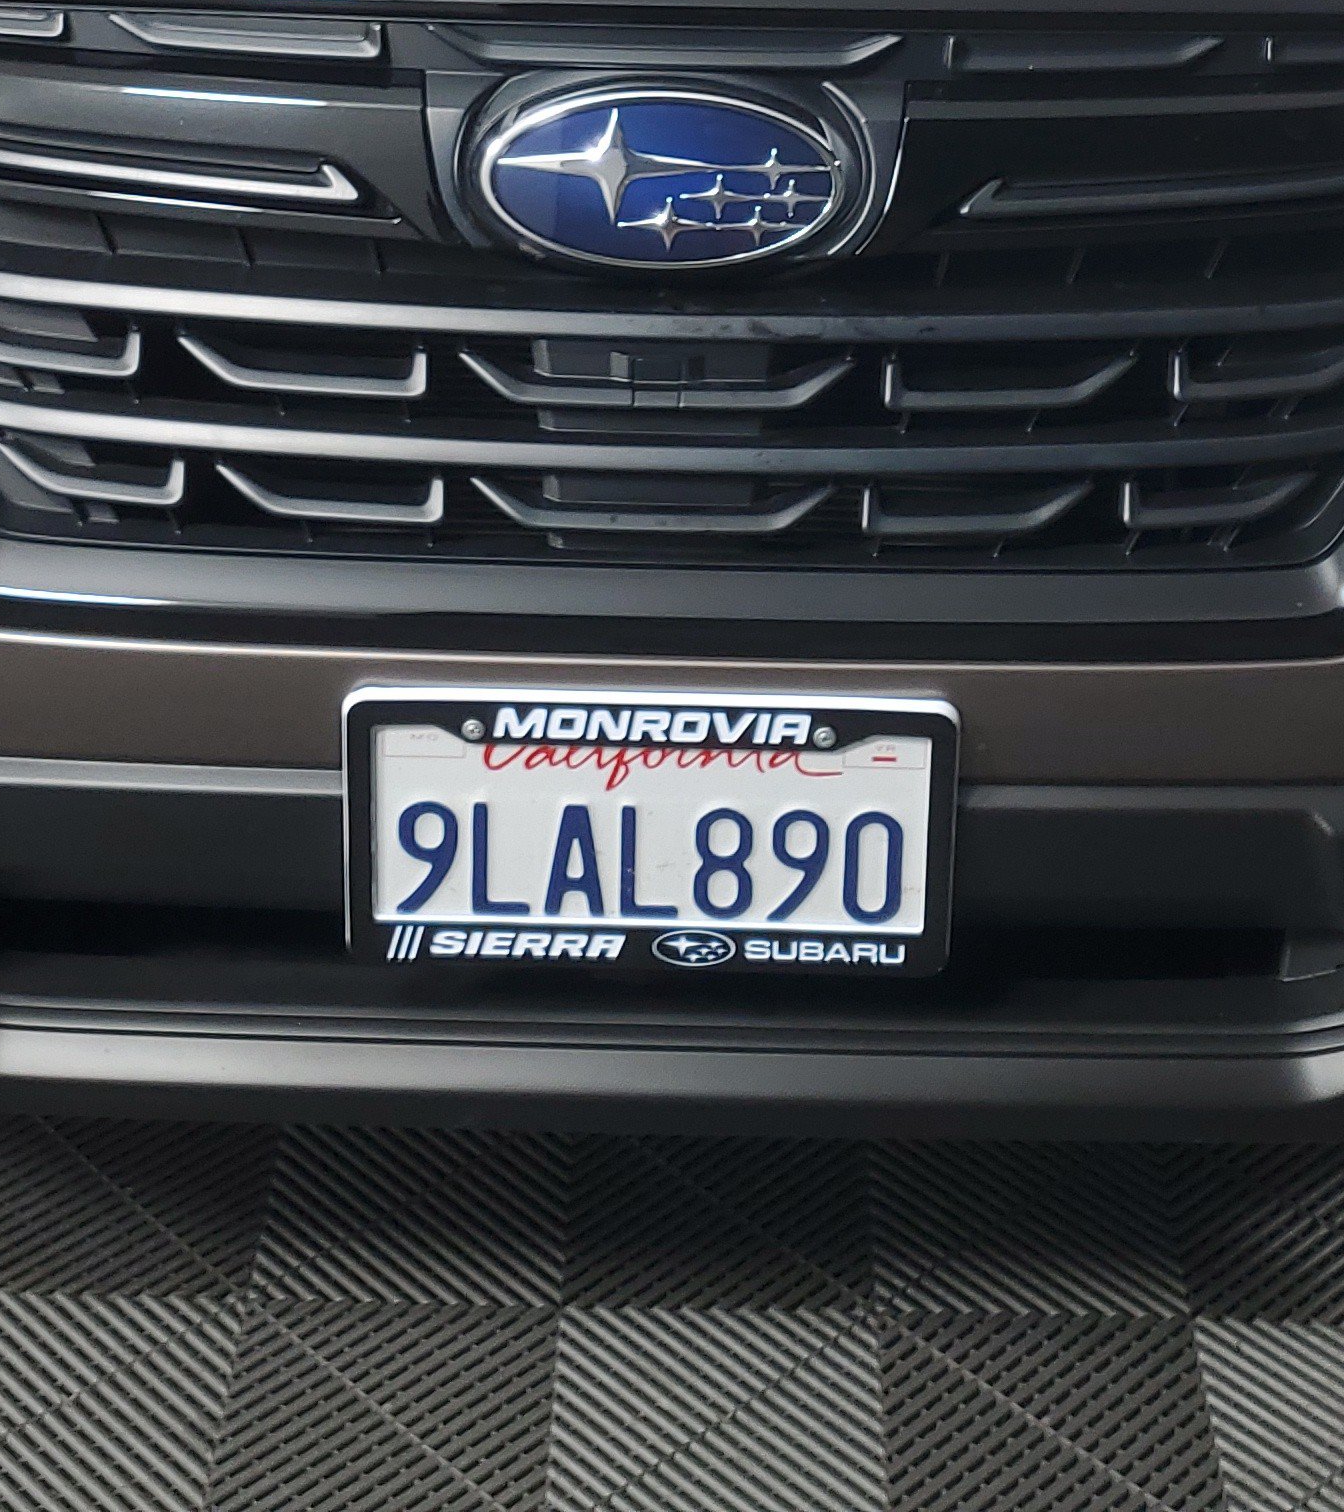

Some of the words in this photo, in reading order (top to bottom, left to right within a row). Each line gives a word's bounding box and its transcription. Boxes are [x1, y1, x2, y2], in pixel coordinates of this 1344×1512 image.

[493, 707, 811, 745] MONROVIA
[396, 800, 903, 925] 9LAL890
[429, 930, 627, 961] SIERRA
[744, 940, 905, 963] SUBARU
